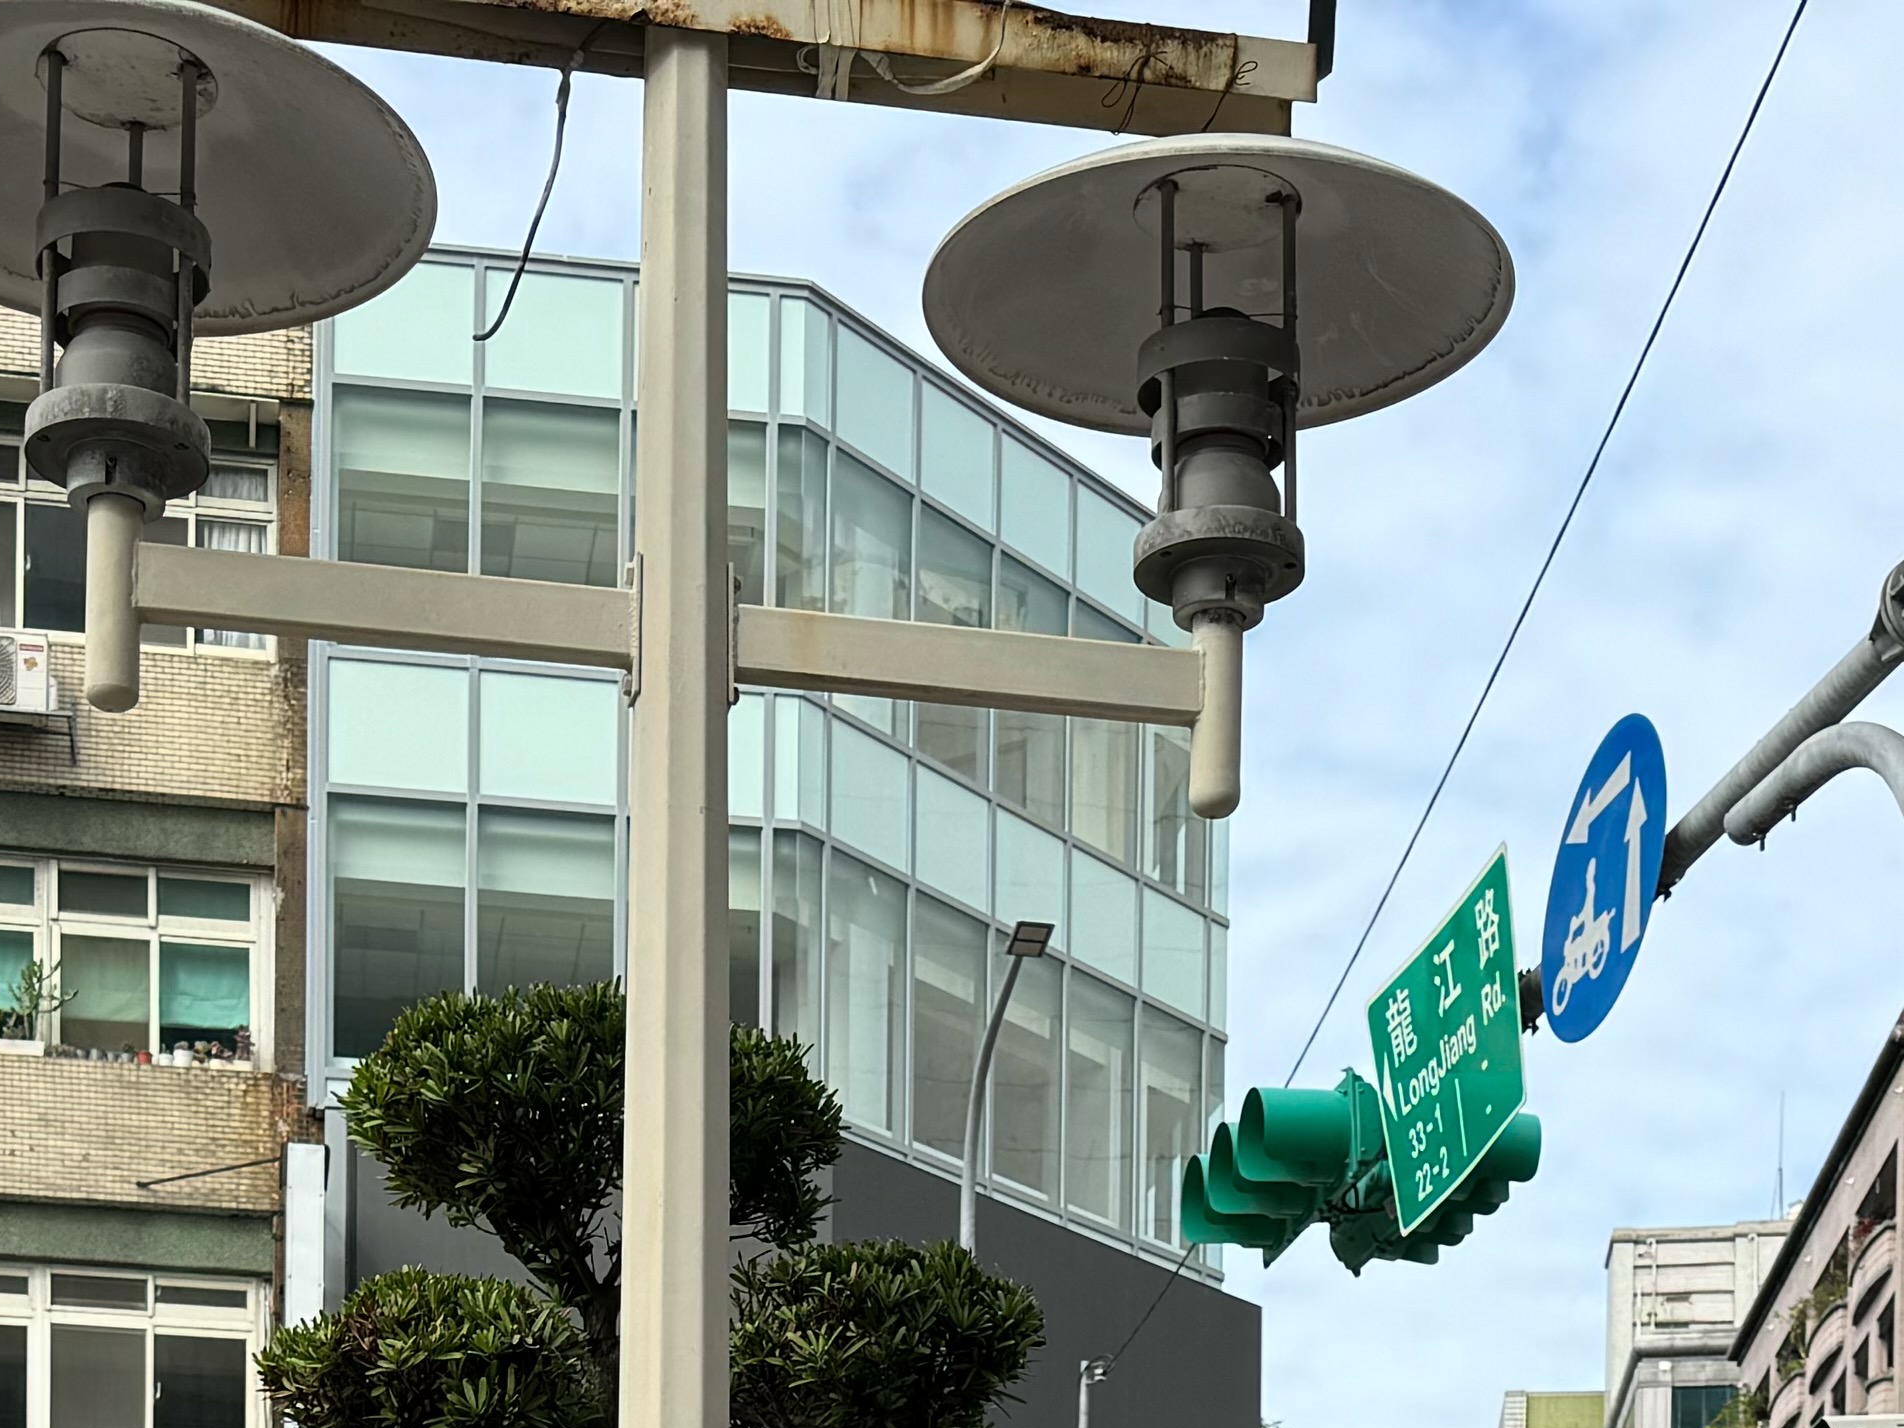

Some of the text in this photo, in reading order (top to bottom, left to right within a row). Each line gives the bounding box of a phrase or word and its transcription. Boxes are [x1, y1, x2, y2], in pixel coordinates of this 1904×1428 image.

[1384, 886, 1501, 1068] 龍江路
[1397, 978, 1507, 1117] LongJiang Rd.
[1408, 1102, 1443, 1160] 33-1
[1414, 1146, 1451, 1204] 22-2
